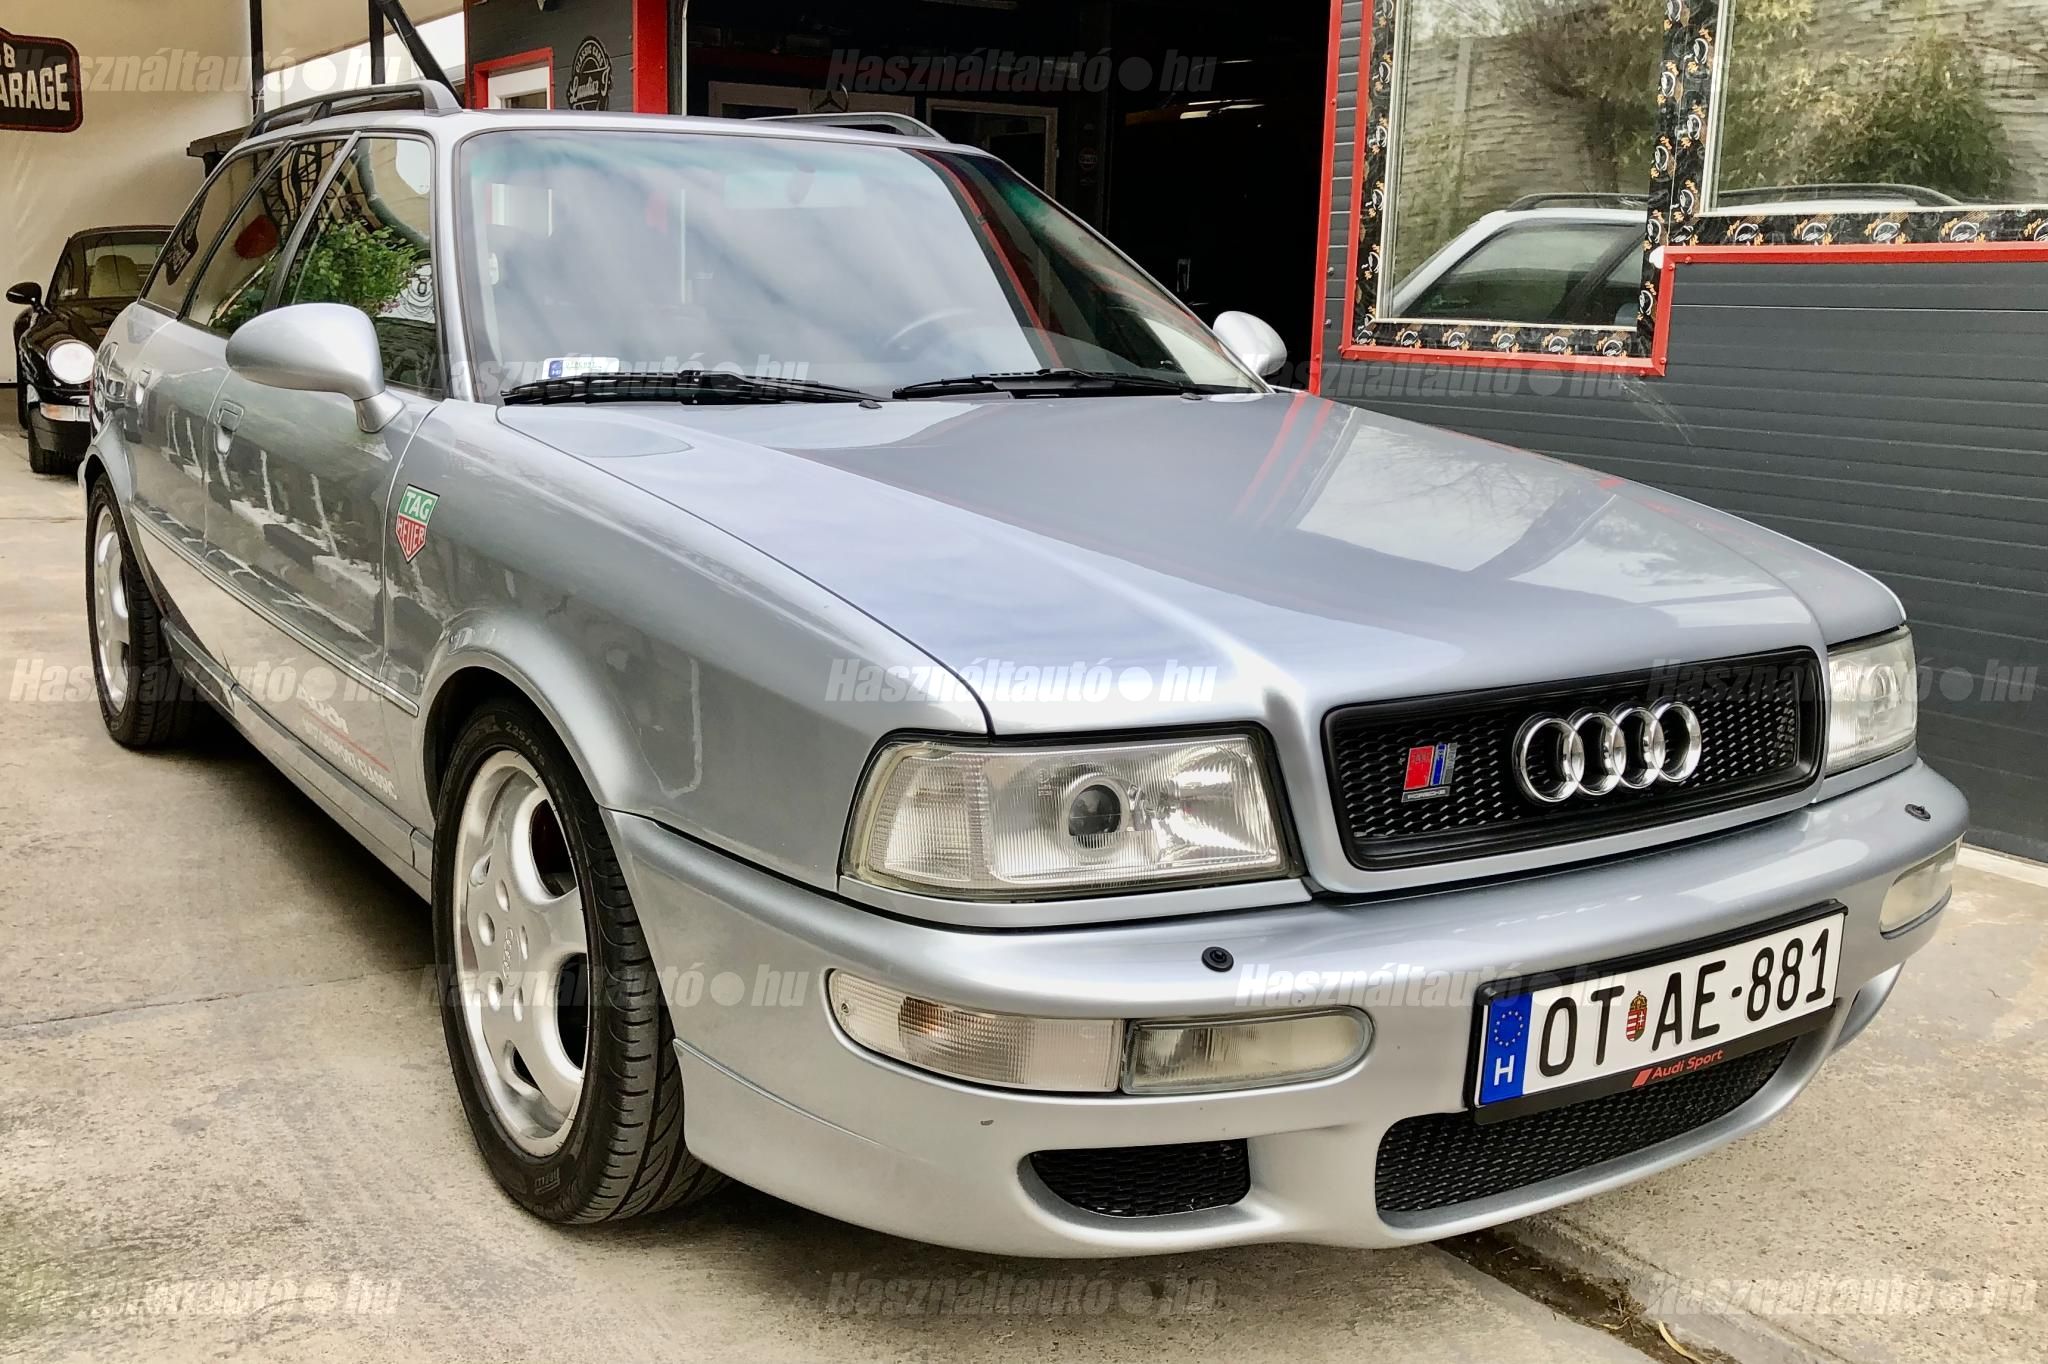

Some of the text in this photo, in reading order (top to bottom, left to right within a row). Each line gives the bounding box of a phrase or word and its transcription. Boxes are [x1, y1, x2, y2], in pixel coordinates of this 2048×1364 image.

[404, 491, 433, 521] TAG
[397, 518, 425, 556] HEUER
[1493, 1053, 1515, 1087] H
[1651, 1049, 1724, 1080] Audi Sport
